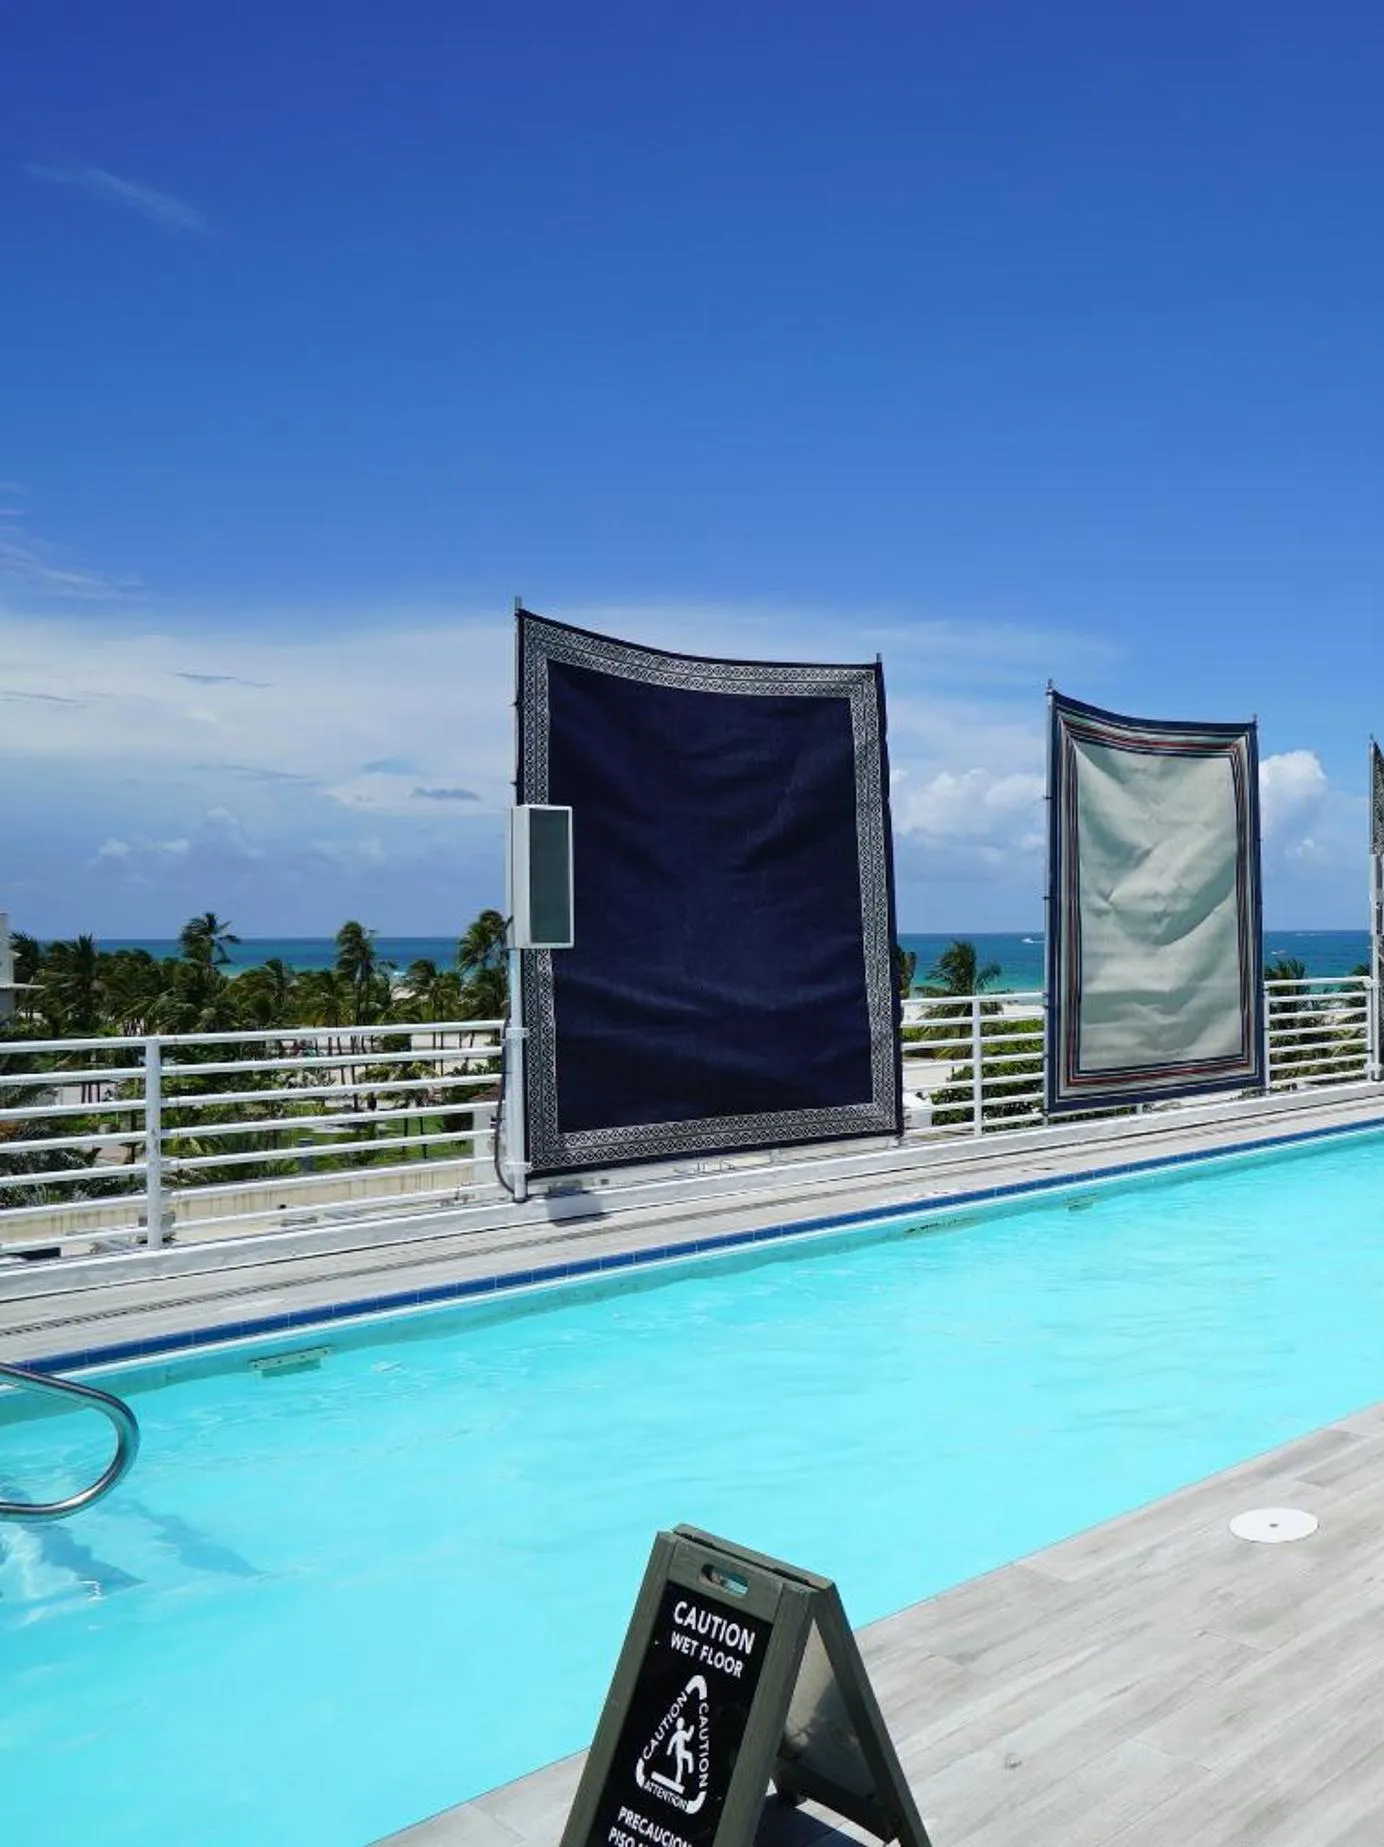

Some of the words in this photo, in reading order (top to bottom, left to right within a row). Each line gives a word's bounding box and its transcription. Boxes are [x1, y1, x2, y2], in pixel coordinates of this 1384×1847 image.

[671, 1630, 699, 1657] WET
[699, 1645, 743, 1679] FLOOR
[673, 1600, 756, 1655] CAUTION
[642, 1691, 688, 1760] CAUTION
[698, 1702, 710, 1789] CAUTION
